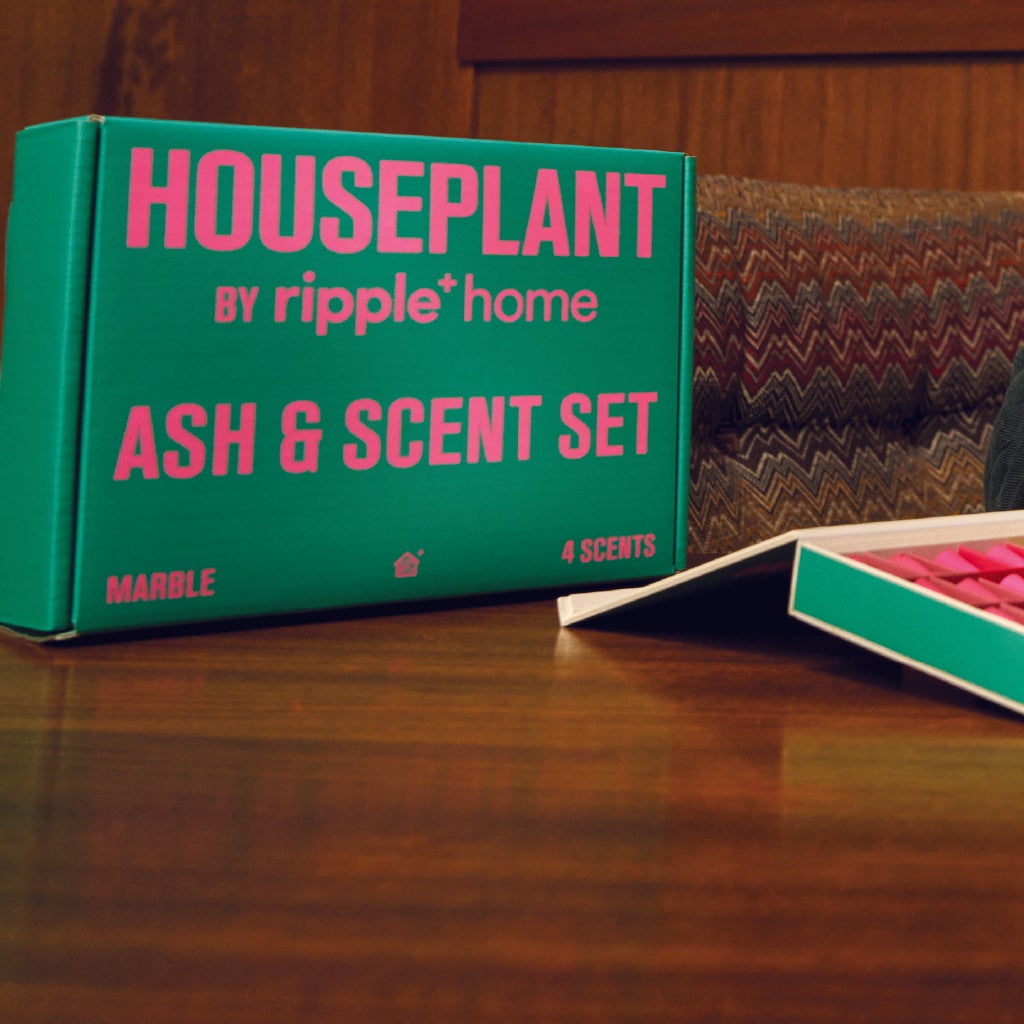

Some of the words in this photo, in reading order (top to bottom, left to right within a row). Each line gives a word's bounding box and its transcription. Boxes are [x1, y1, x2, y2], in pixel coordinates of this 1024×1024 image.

[126, 147, 667, 259] HOUSEPLANT
[215, 286, 259, 323] BY
[113, 403, 256, 481] ASH
[280, 400, 323, 474] &
[343, 395, 543, 471] SCENT
[558, 391, 659, 459] SET
[561, 540, 575, 564] 4
[580, 533, 656, 563] SCENTS
[106, 568, 216, 604] MARBLE
